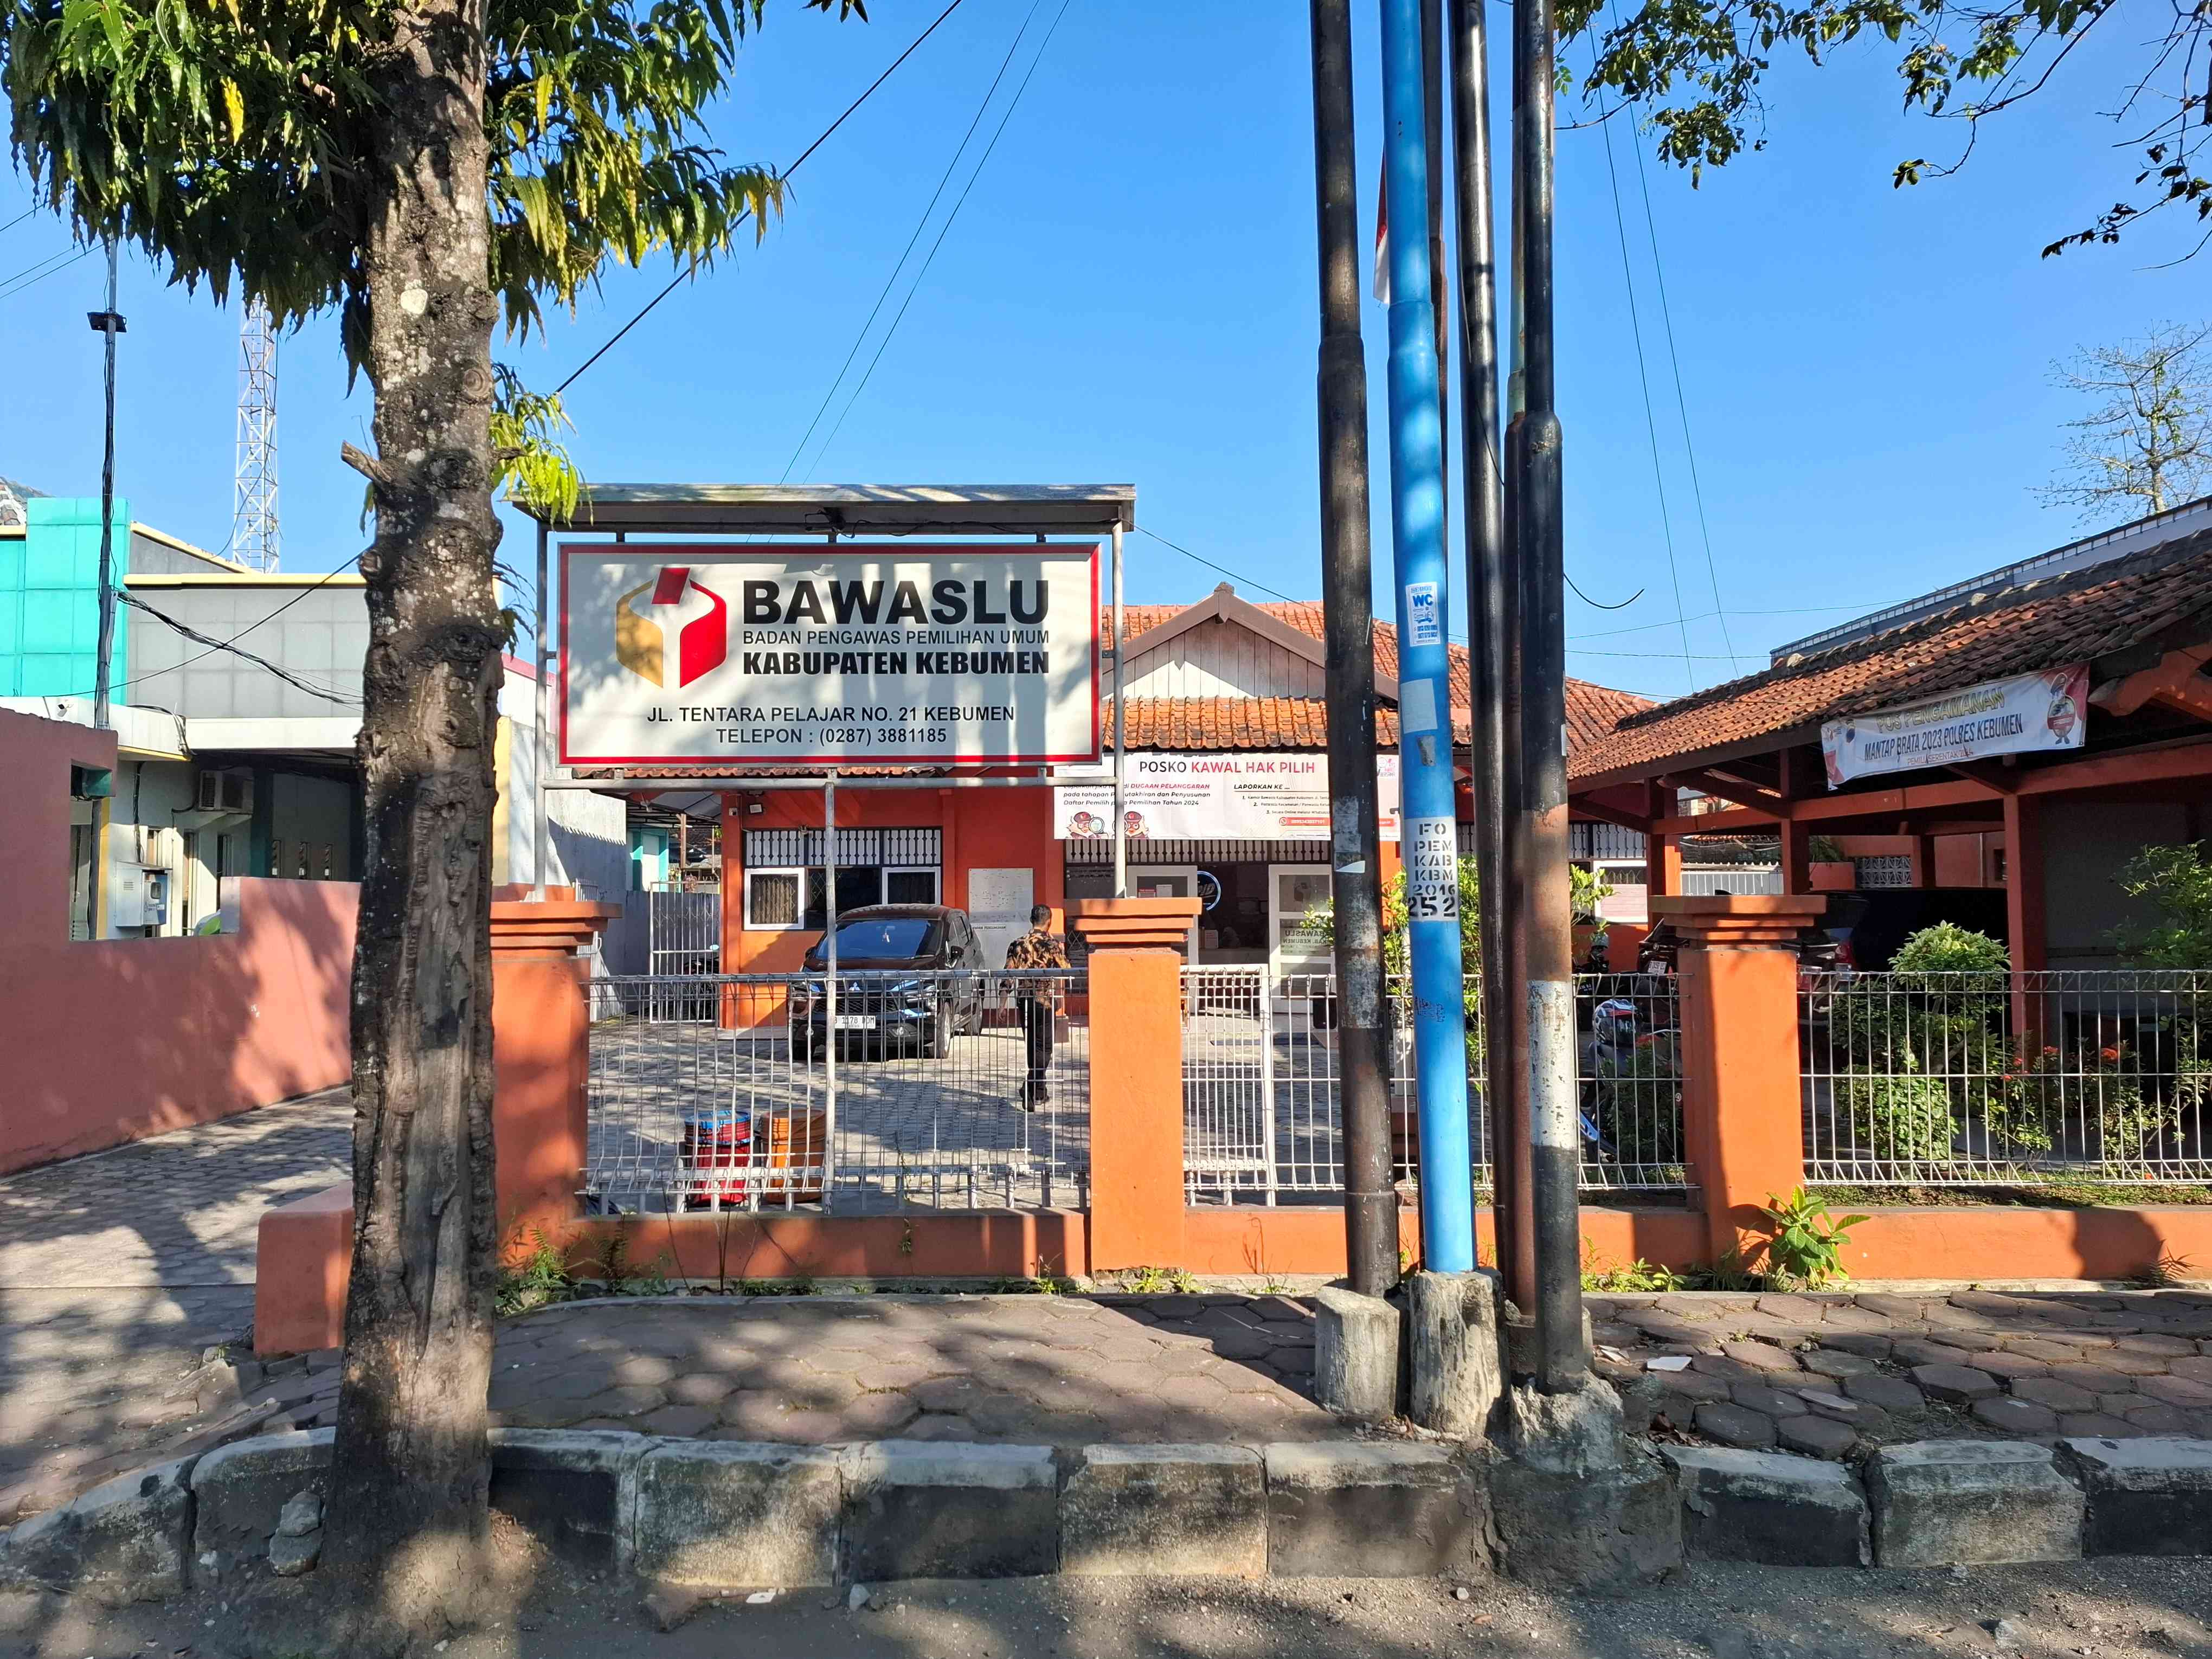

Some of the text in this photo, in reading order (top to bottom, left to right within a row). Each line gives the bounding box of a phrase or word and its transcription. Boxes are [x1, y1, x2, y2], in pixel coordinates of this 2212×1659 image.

[743, 580, 1049, 625] BAWASLU
[1412, 594, 1433, 607] WC
[743, 630, 1049, 644] BADAN PENGAWAS PEMILIHAN UMUM
[743, 652, 1049, 675] KABUPATEN KEBUMEN
[647, 706, 1014, 722] JL. TENTARA PELAJAR NO. 21 KEBUMEN
[1876, 687, 2005, 733] POS PENGAMANAN
[716, 728, 947, 746] TELEPON : (0287) 3881185
[1865, 713, 2023, 761] MANTAP BRATA 2023 POLRES KEBUMEN
[1928, 751, 1958, 763] SERENTAK
[1139, 761, 1315, 773] POSKO KAWAL HAK PILIH
[1414, 840, 1452, 852] PEM
[1414, 855, 1452, 866] KAB
[1415, 869, 1453, 881] KBM
[1413, 884, 1456, 896] 2016
[1408, 895, 1456, 917] 252
